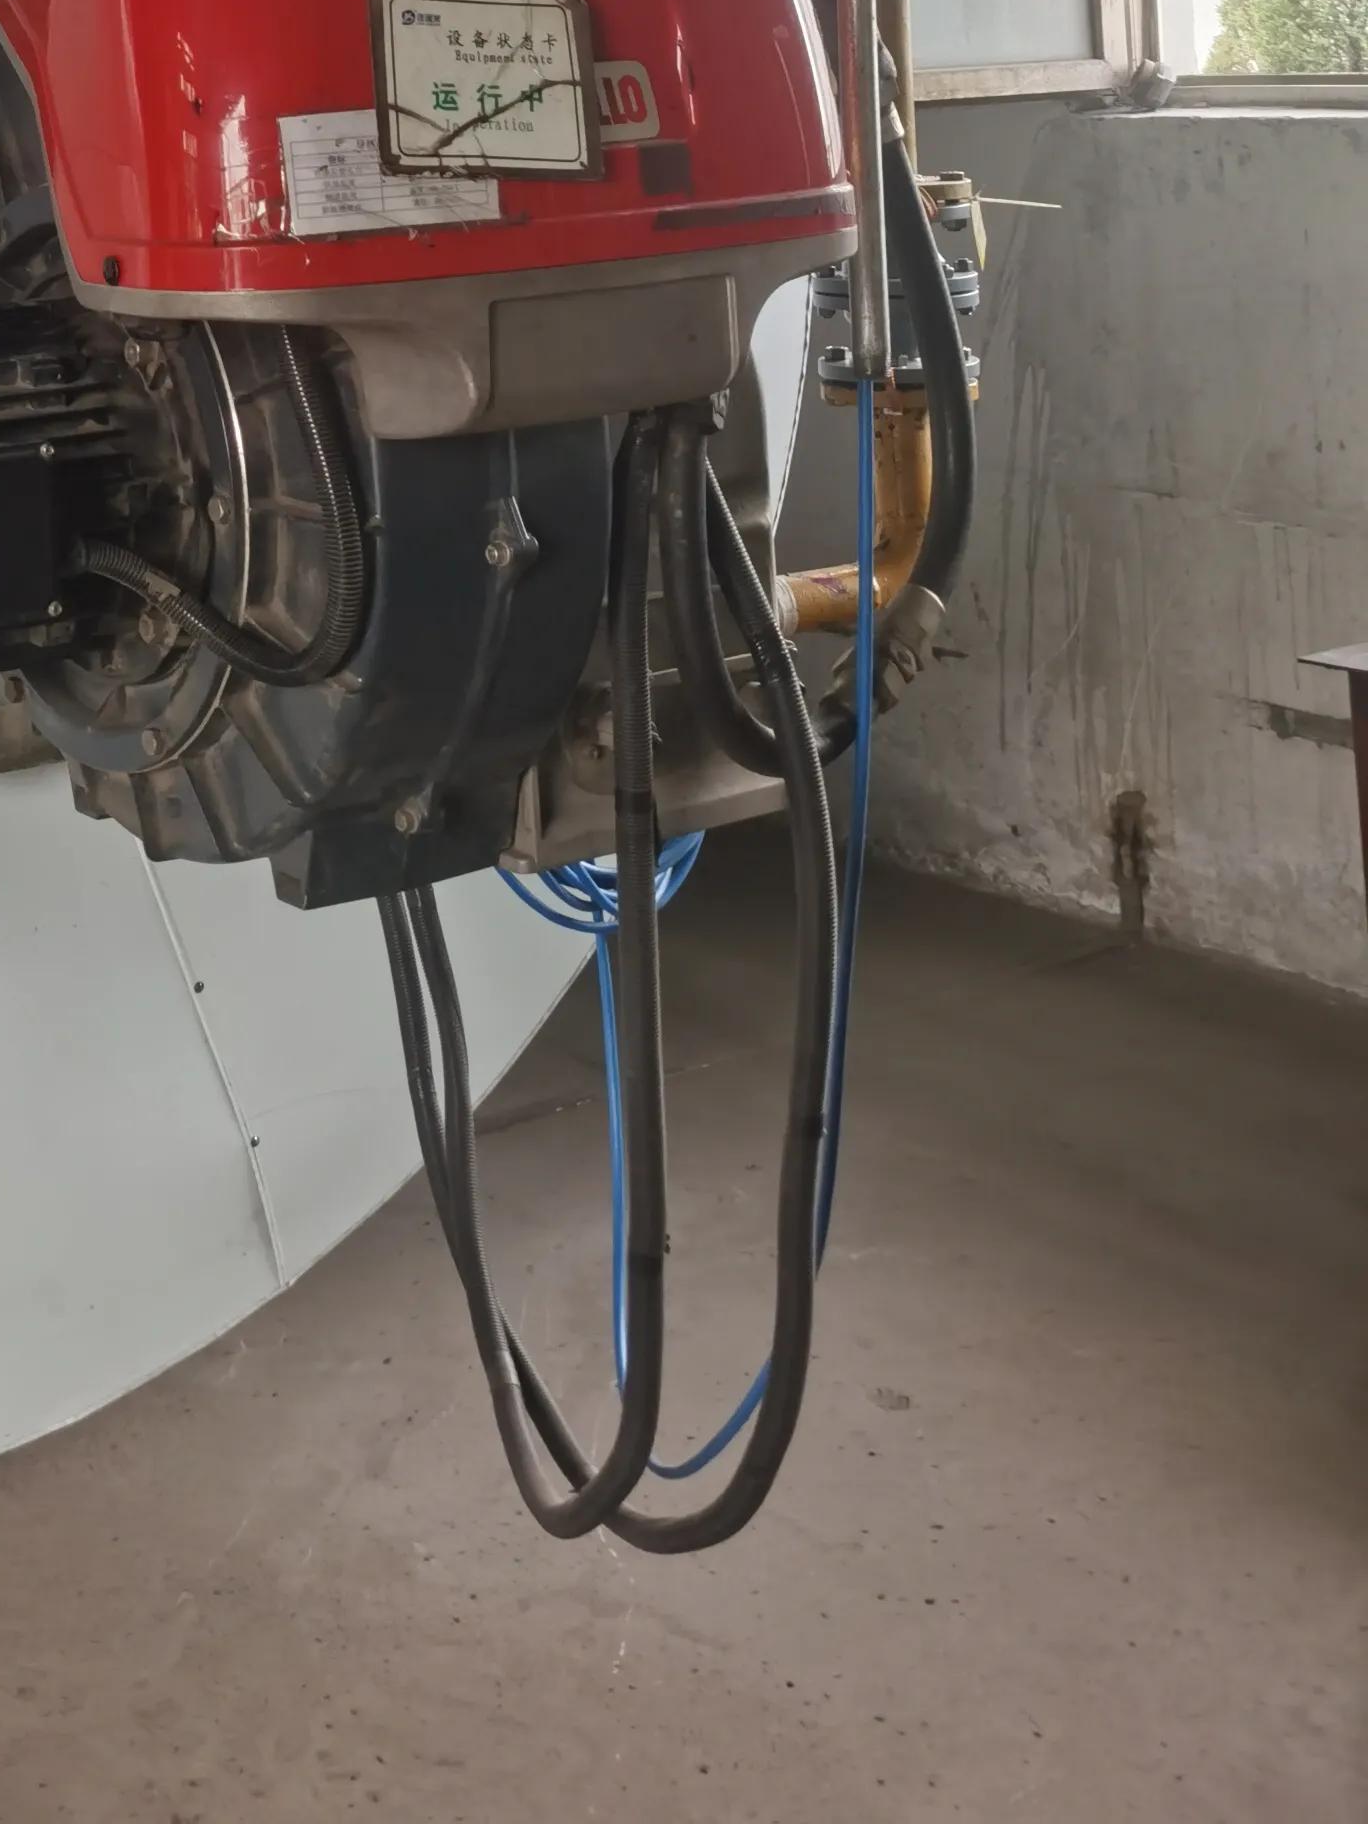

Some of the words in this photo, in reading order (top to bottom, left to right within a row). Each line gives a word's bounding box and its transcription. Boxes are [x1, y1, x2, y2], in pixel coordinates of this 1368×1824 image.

[446, 29, 558, 53] 设备状态卡
[431, 81, 544, 114] 运行中
